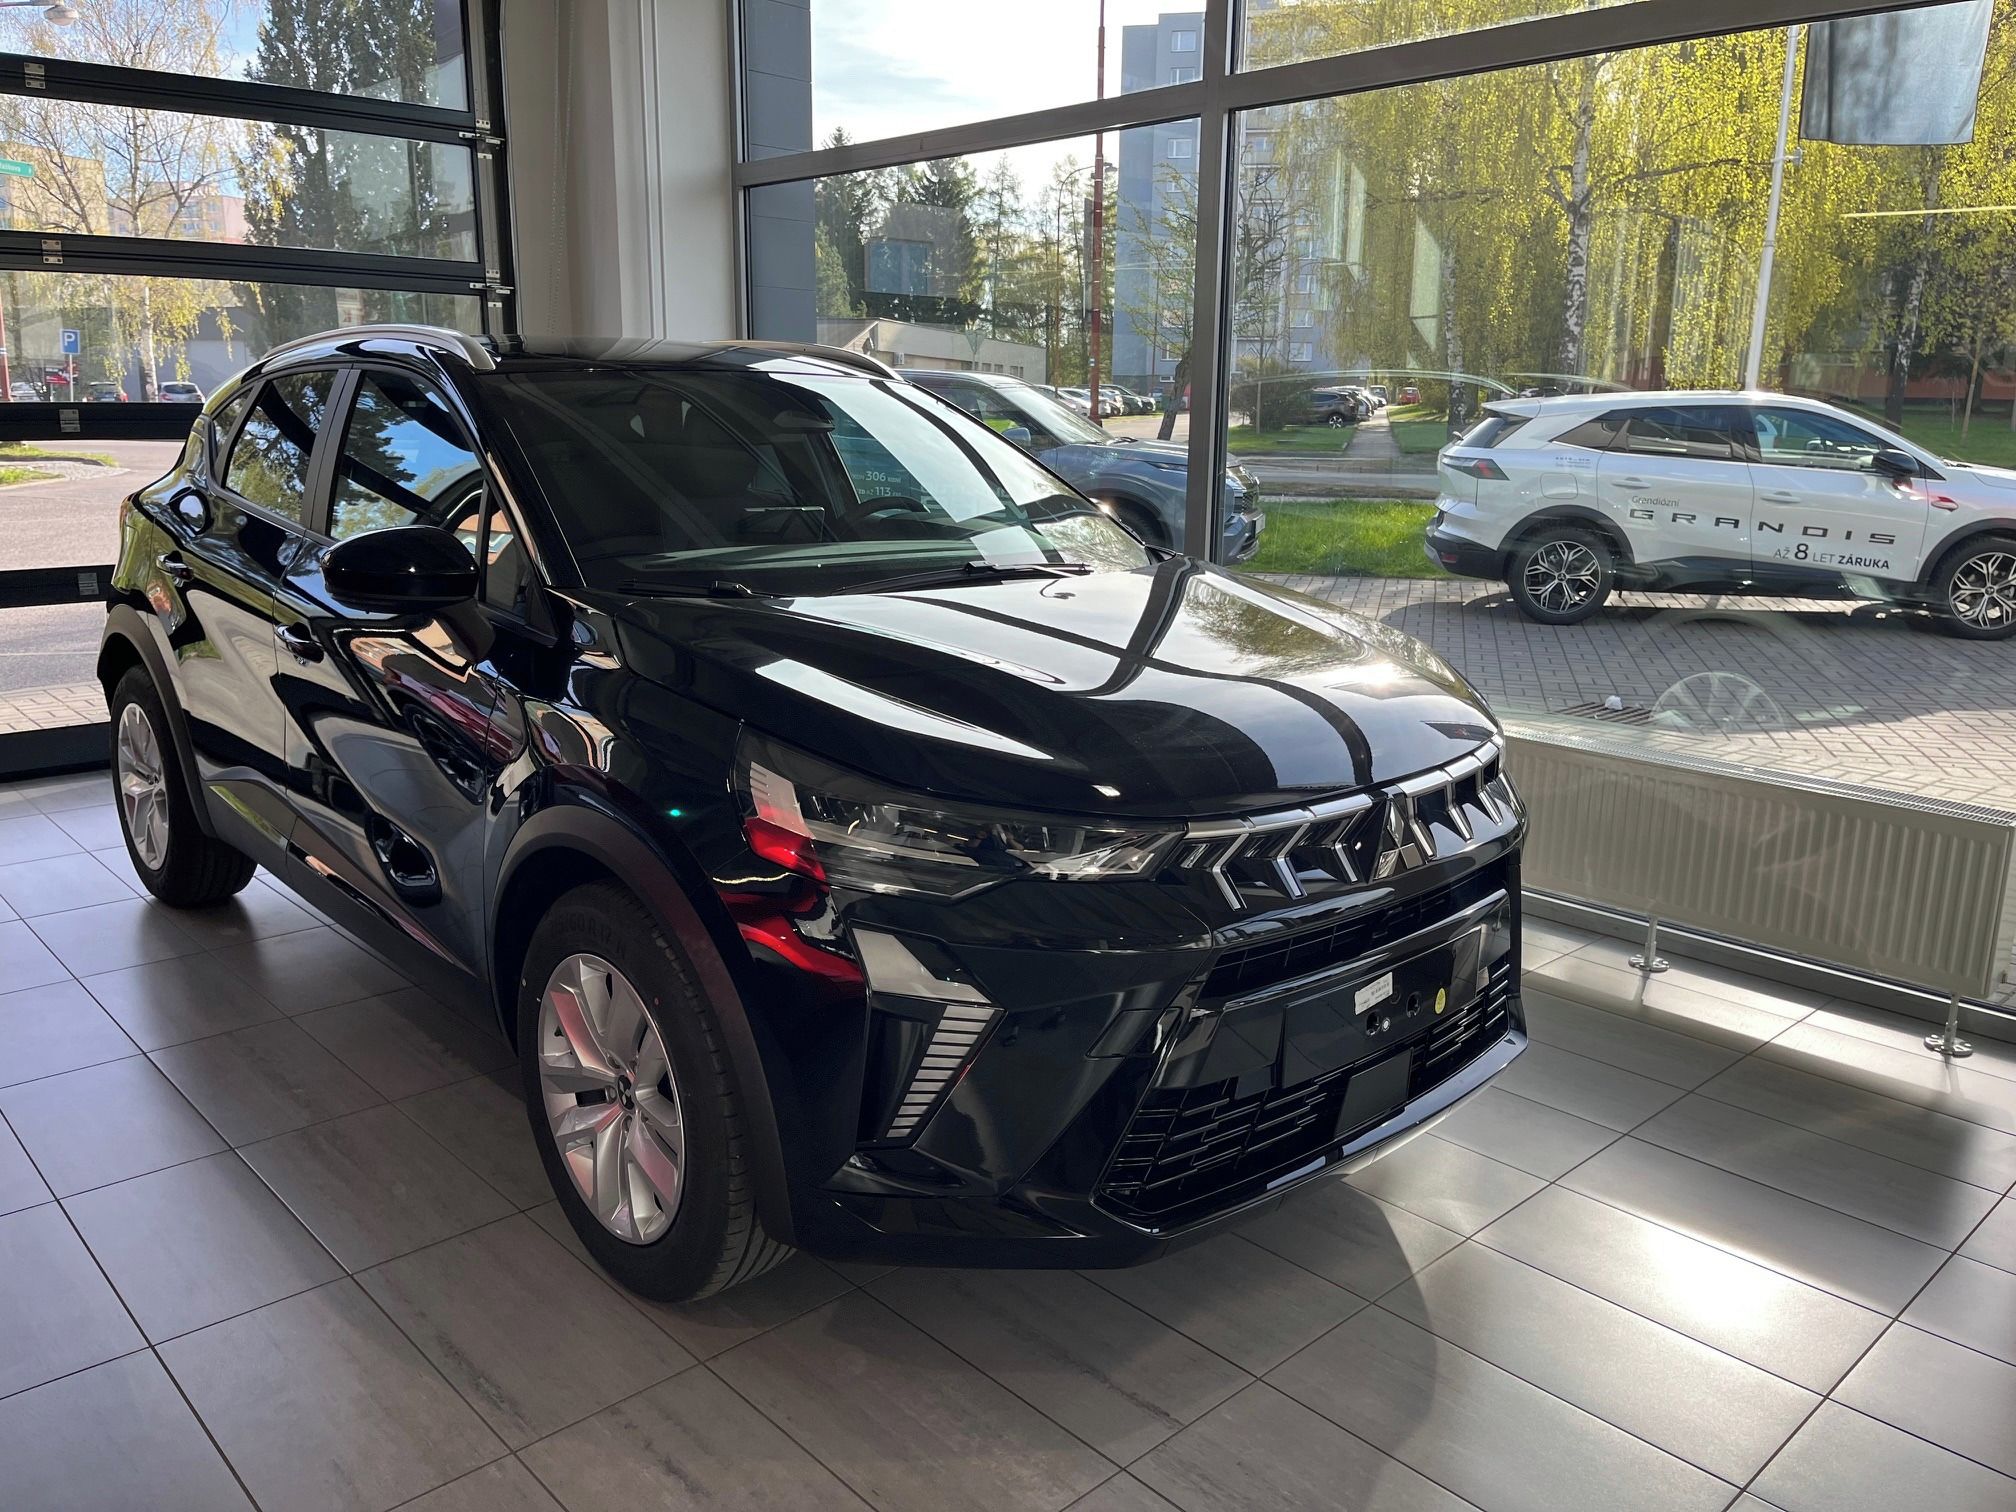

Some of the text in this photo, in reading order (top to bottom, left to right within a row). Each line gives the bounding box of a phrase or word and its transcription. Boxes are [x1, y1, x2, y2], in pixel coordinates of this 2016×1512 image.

[64, 332, 75, 346] P
[865, 471, 886, 482] 306
[875, 486, 891, 497] 113
[1629, 508, 1896, 545] GRANDIS
[1773, 543, 1890, 570] AŽ 8 LET ZÁRUKA
